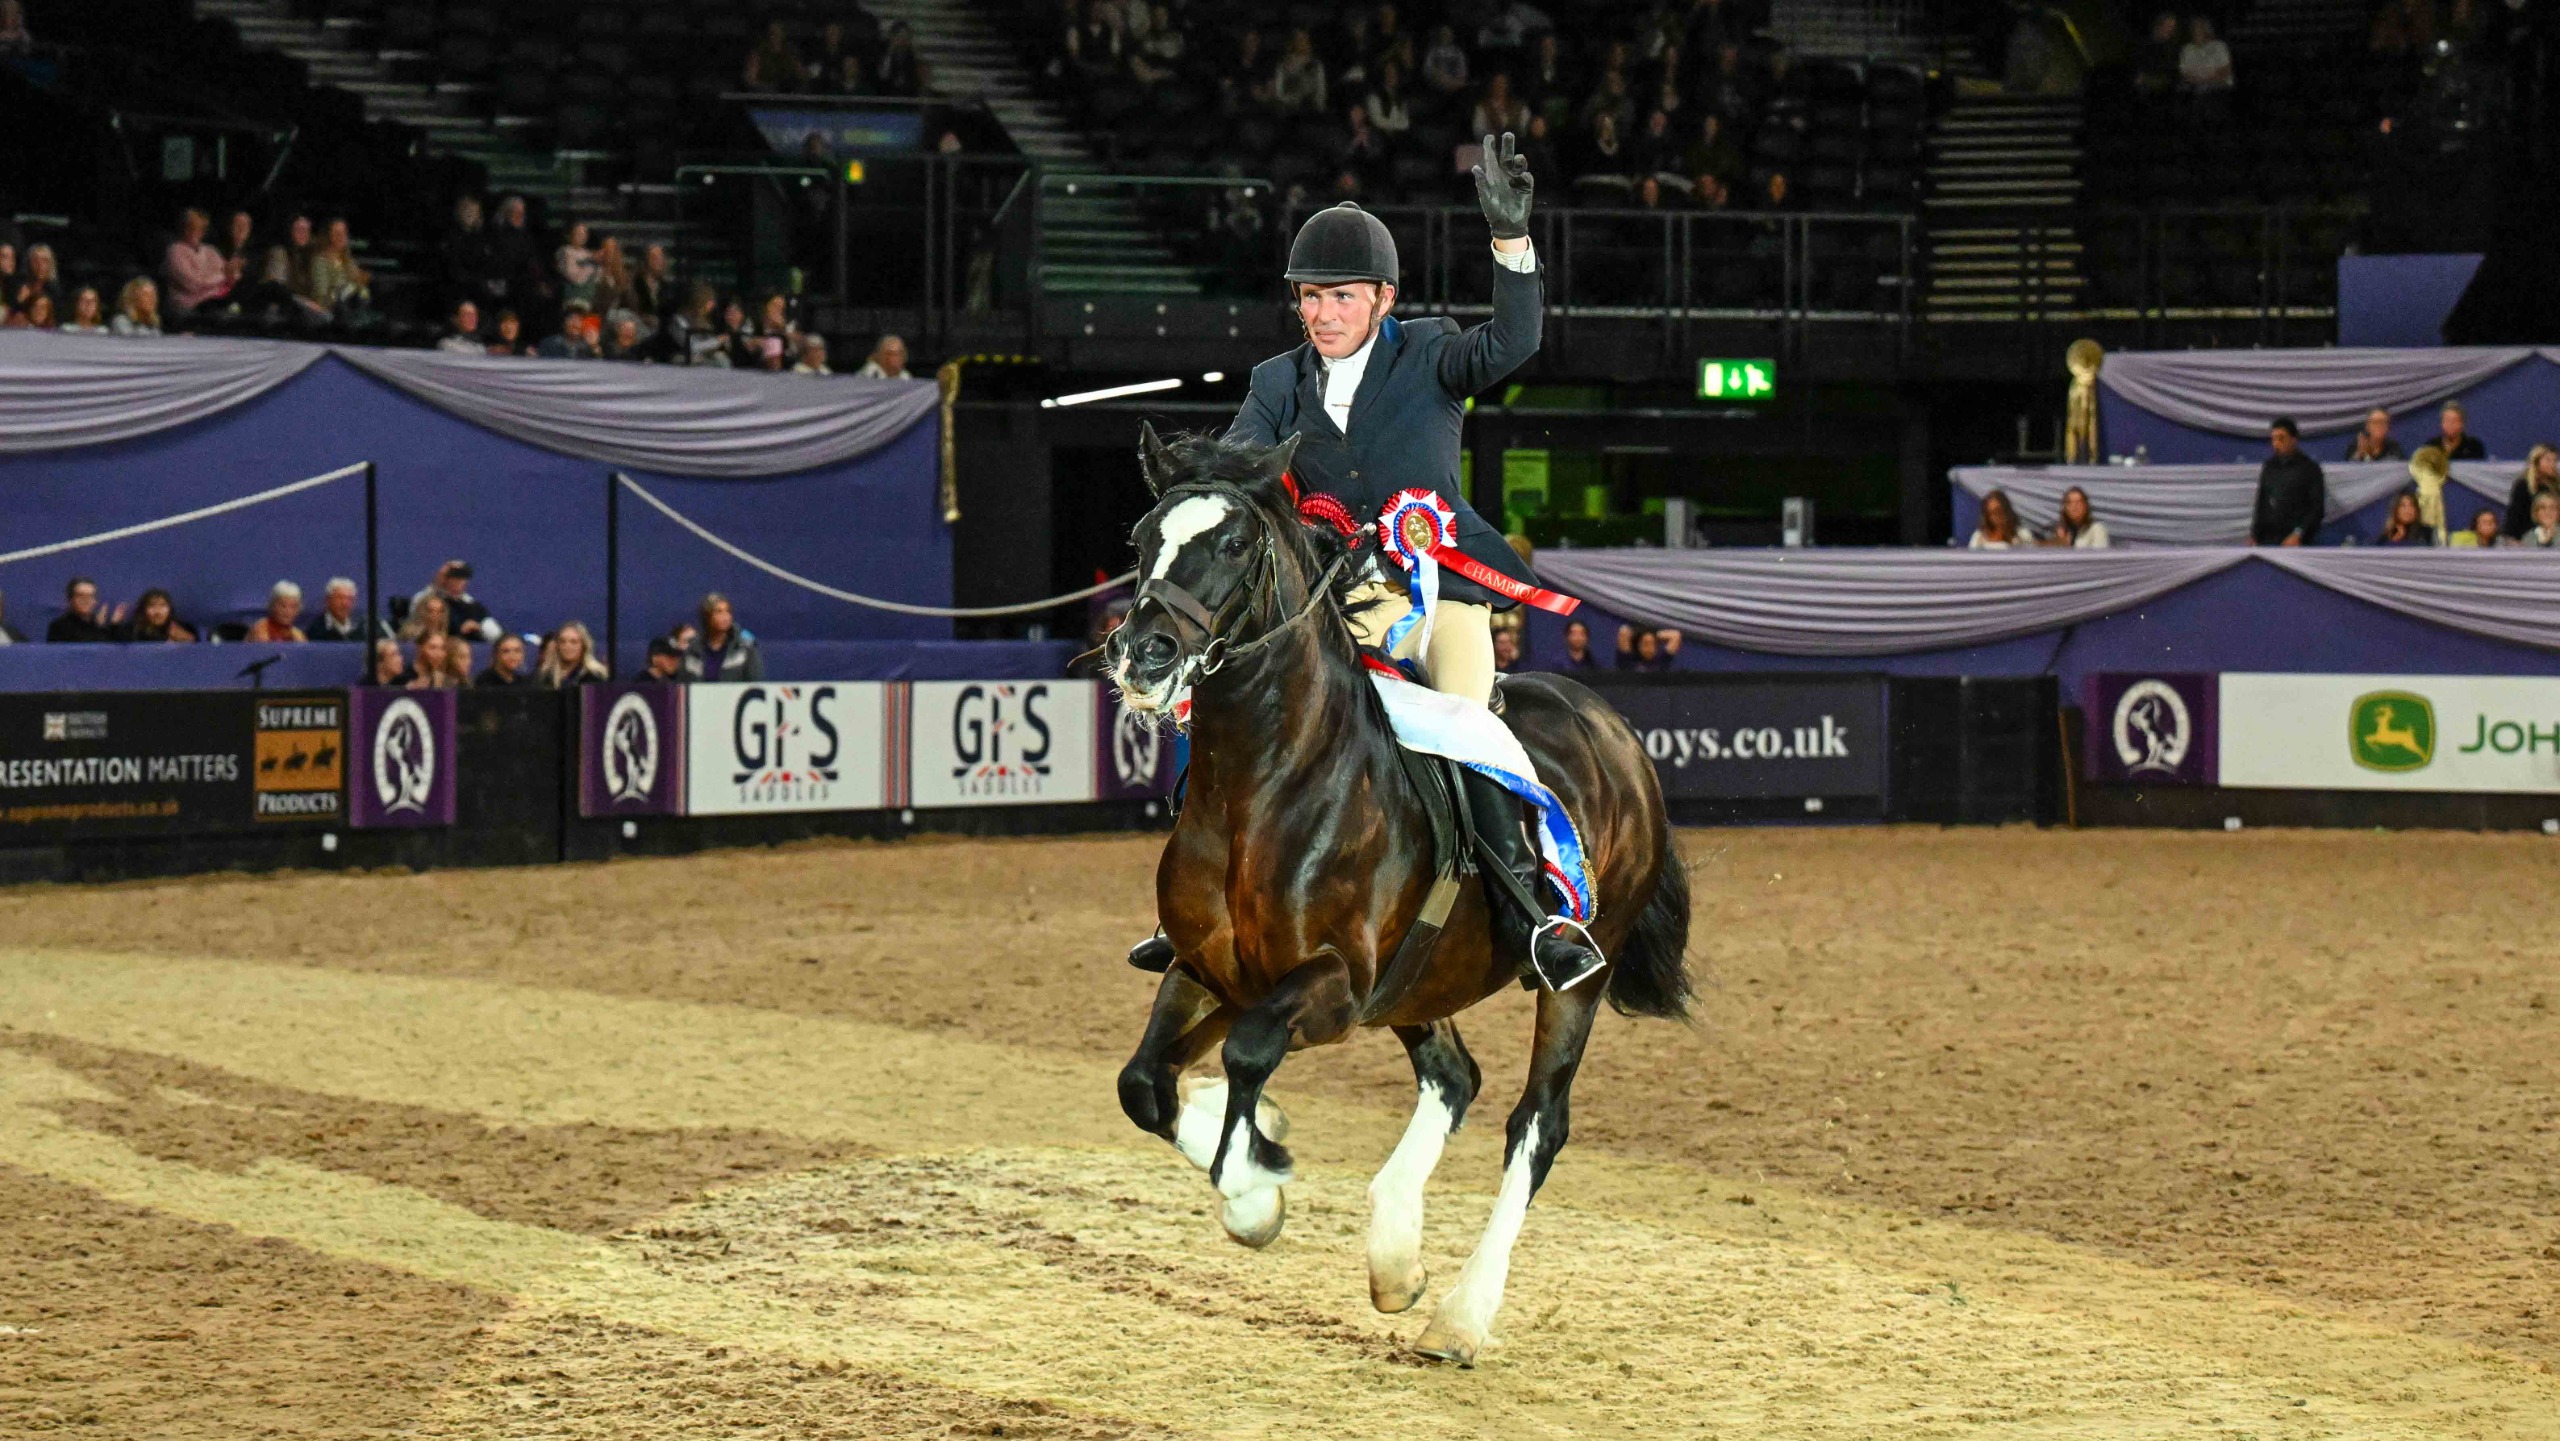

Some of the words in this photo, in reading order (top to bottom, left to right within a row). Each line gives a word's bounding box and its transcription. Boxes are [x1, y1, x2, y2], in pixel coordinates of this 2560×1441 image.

[1464, 561, 1537, 600] CHAMPION
[259, 705, 337, 728] SUPREME
[1624, 715, 1849, 768] oys.co.uk
[148, 754, 239, 782] MATTERS
[739, 784, 829, 802] SADDLES
[959, 780, 1041, 796] SADDLES
[258, 793, 338, 813] PRODUCTS
